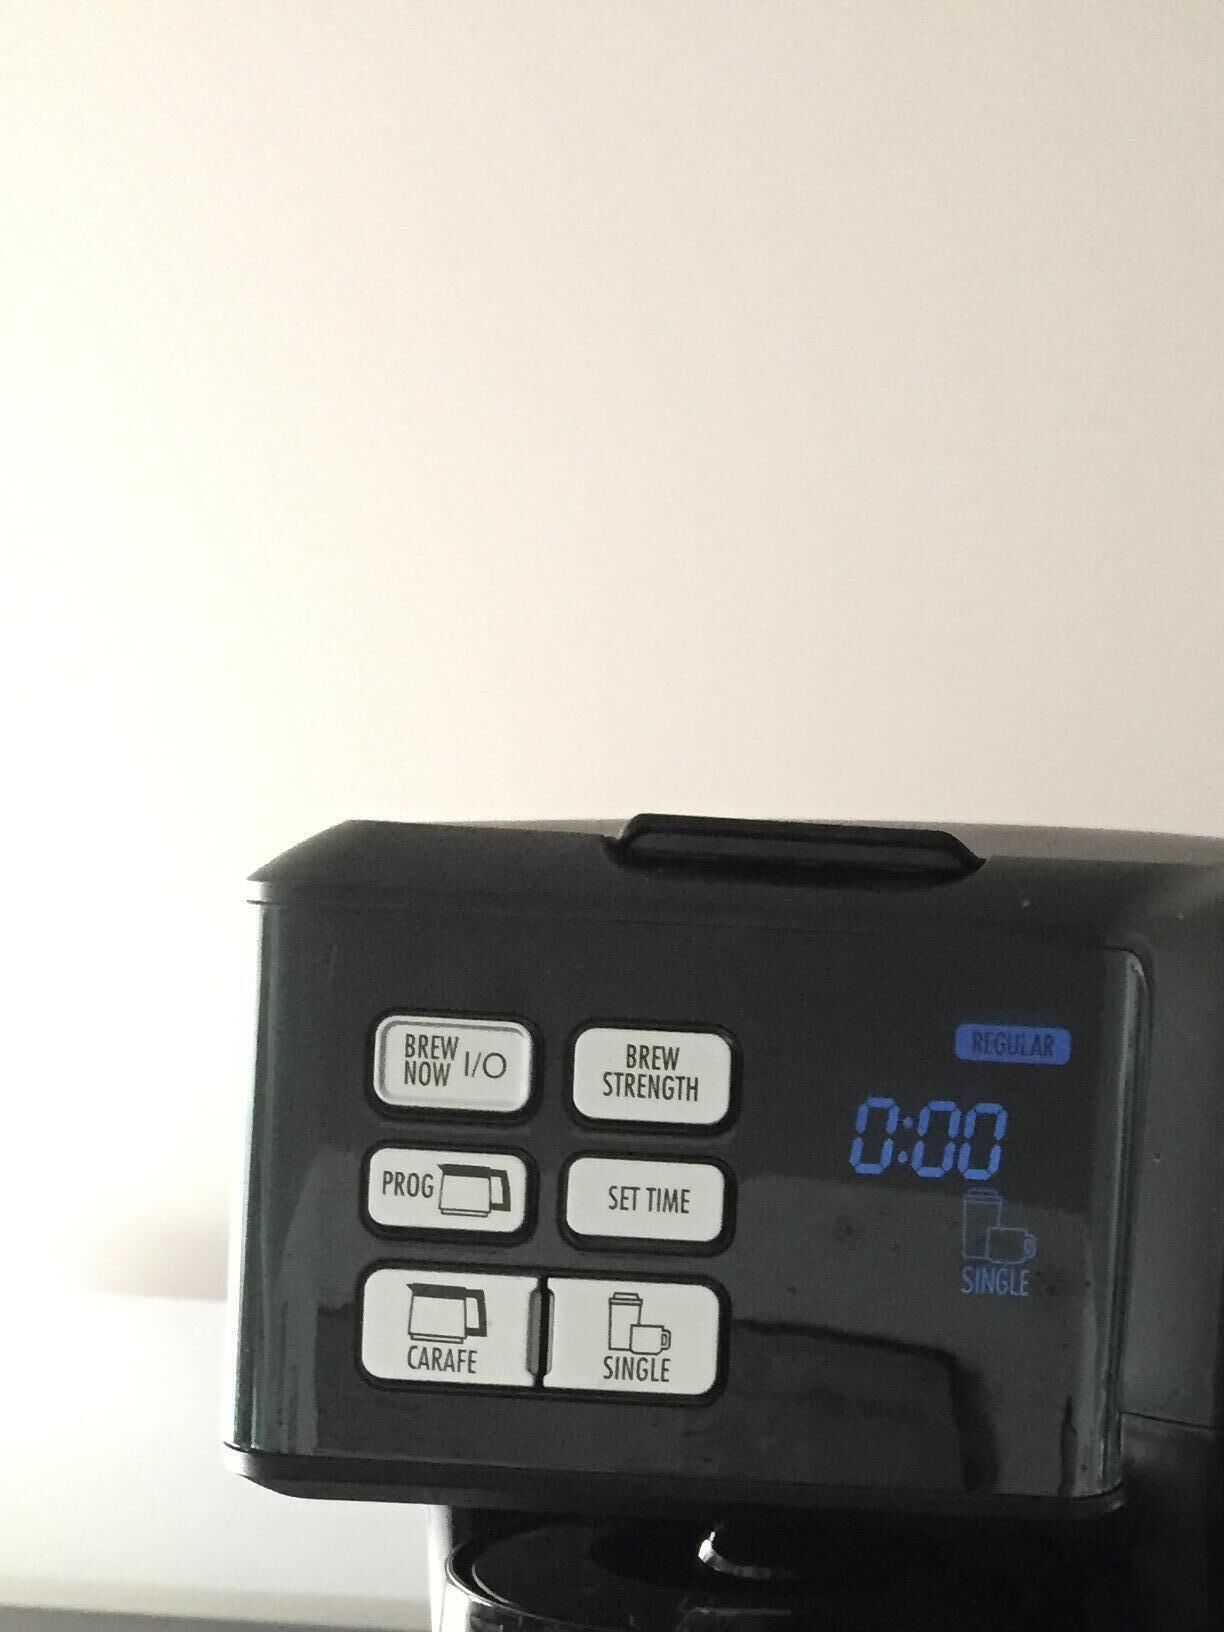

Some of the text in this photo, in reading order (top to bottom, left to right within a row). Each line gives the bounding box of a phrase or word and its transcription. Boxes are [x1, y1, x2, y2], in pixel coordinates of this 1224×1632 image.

[404, 1033, 459, 1061] BREW
[626, 1043, 681, 1071] BREW
[971, 1031, 1055, 1056] REGULAR
[404, 1061, 451, 1087] NOW
[602, 1072, 700, 1102] STRENGTH
[850, 1096, 1008, 1180] 0:00
[382, 1170, 434, 1199] PROG
[608, 1185, 691, 1215] SET TIME
[960, 1266, 1030, 1297] SINGLE
[407, 1345, 478, 1374] CARAFE
[603, 1356, 671, 1384] SINGLE
